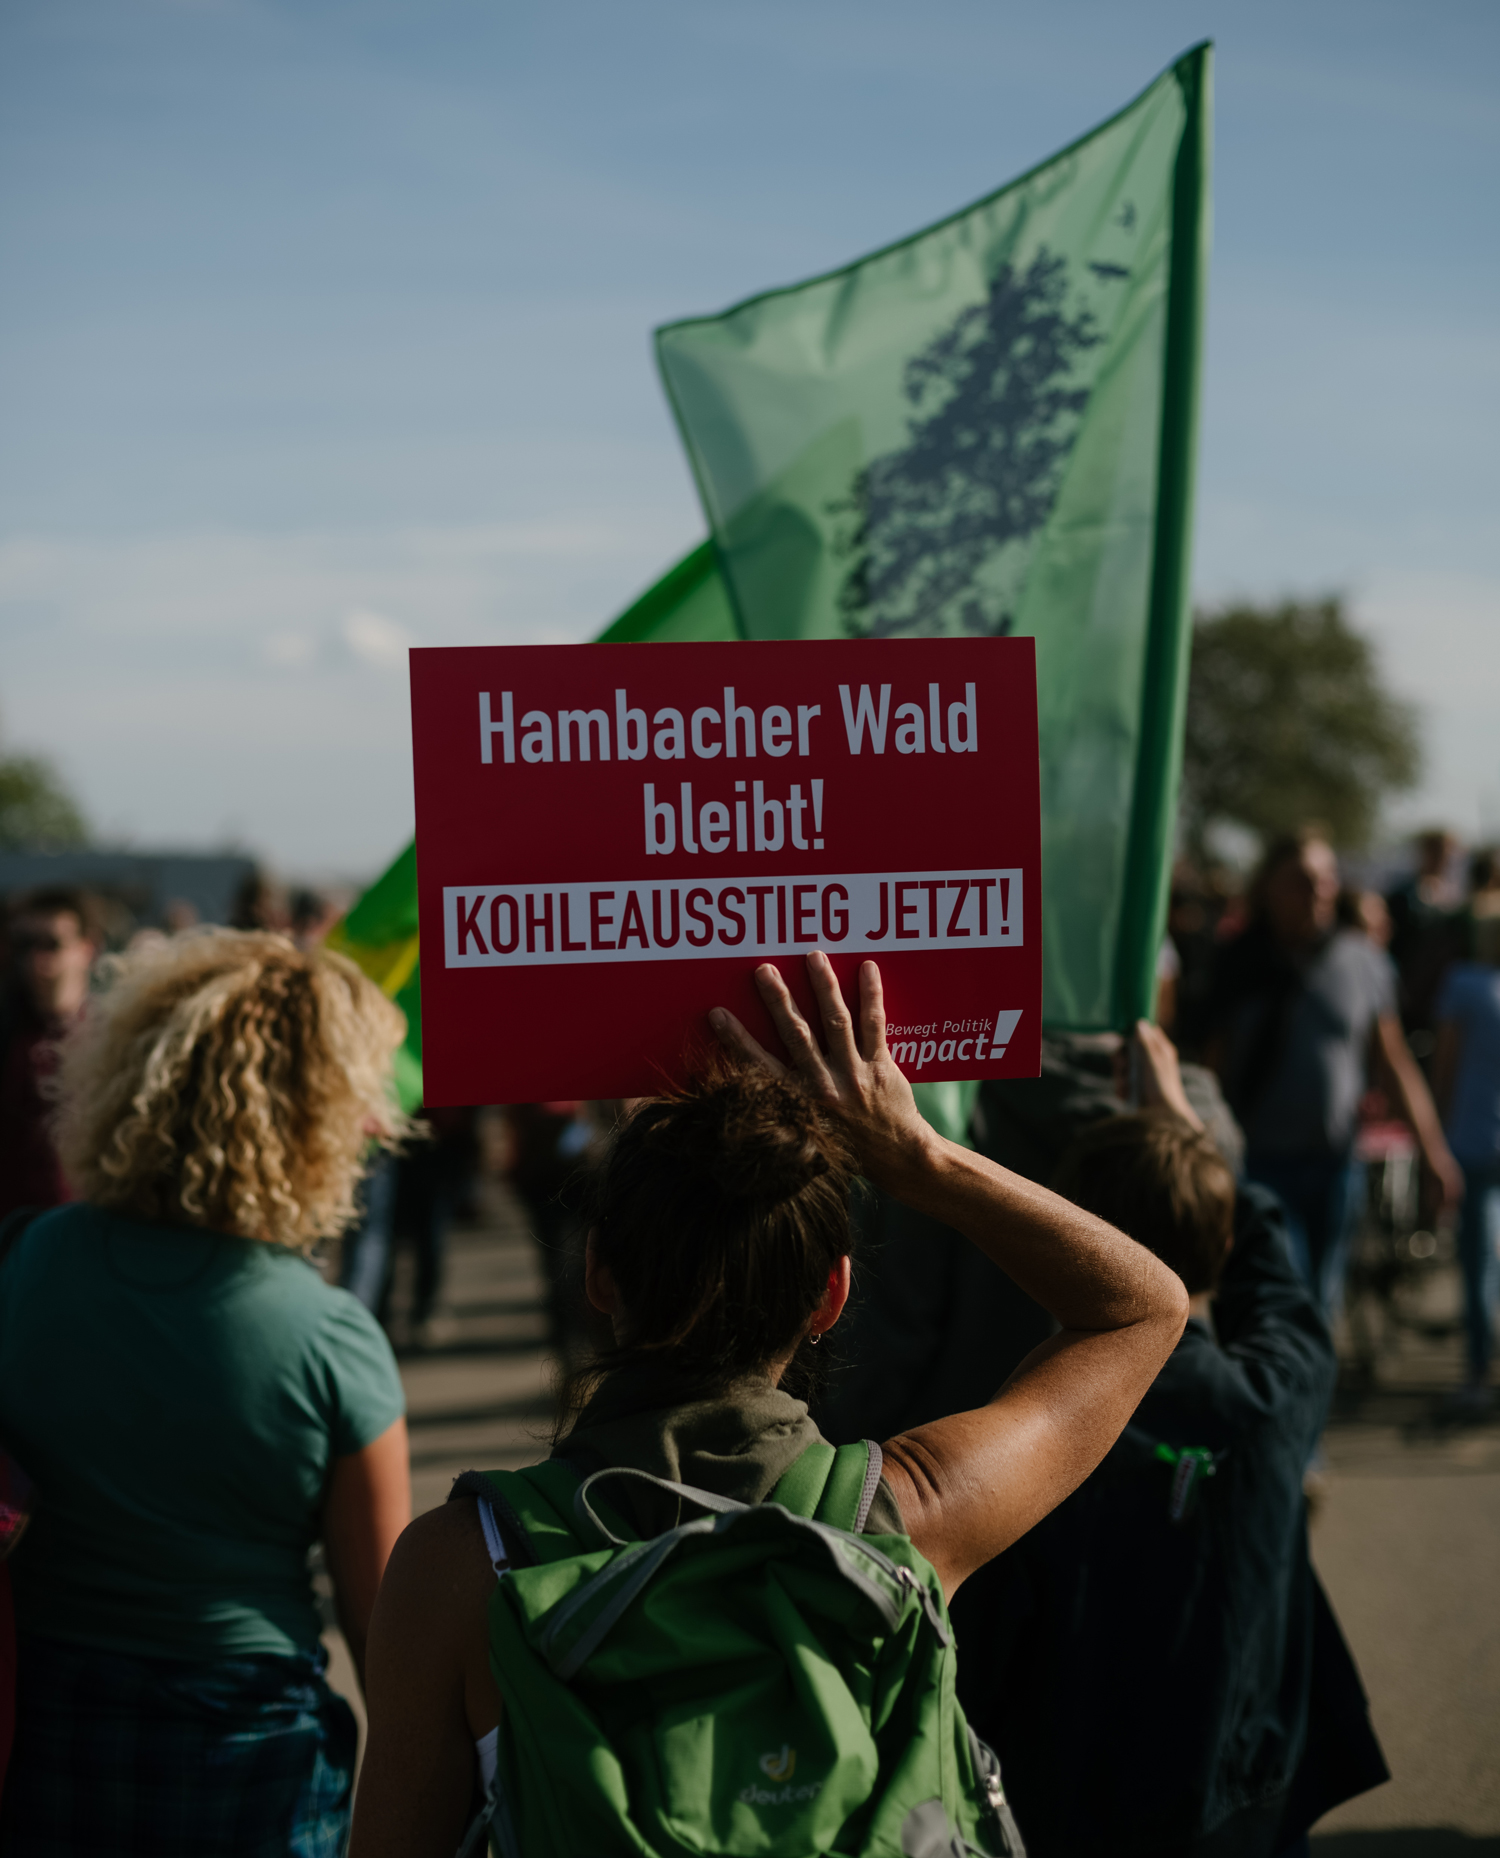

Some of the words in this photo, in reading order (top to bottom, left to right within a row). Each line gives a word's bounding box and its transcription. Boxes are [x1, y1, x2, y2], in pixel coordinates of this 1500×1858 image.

[479, 686, 821, 764] Hambacher
[838, 682, 978, 756] Wald
[643, 778, 825, 855] bleibt!
[456, 883, 849, 955] KOHLEAUSSTIEG
[865, 878, 1011, 941] JETZT!
[886, 1022, 938, 1037] Bewegt
[942, 1018, 992, 1033] Politik
[887, 1009, 1024, 1070] mpact!
